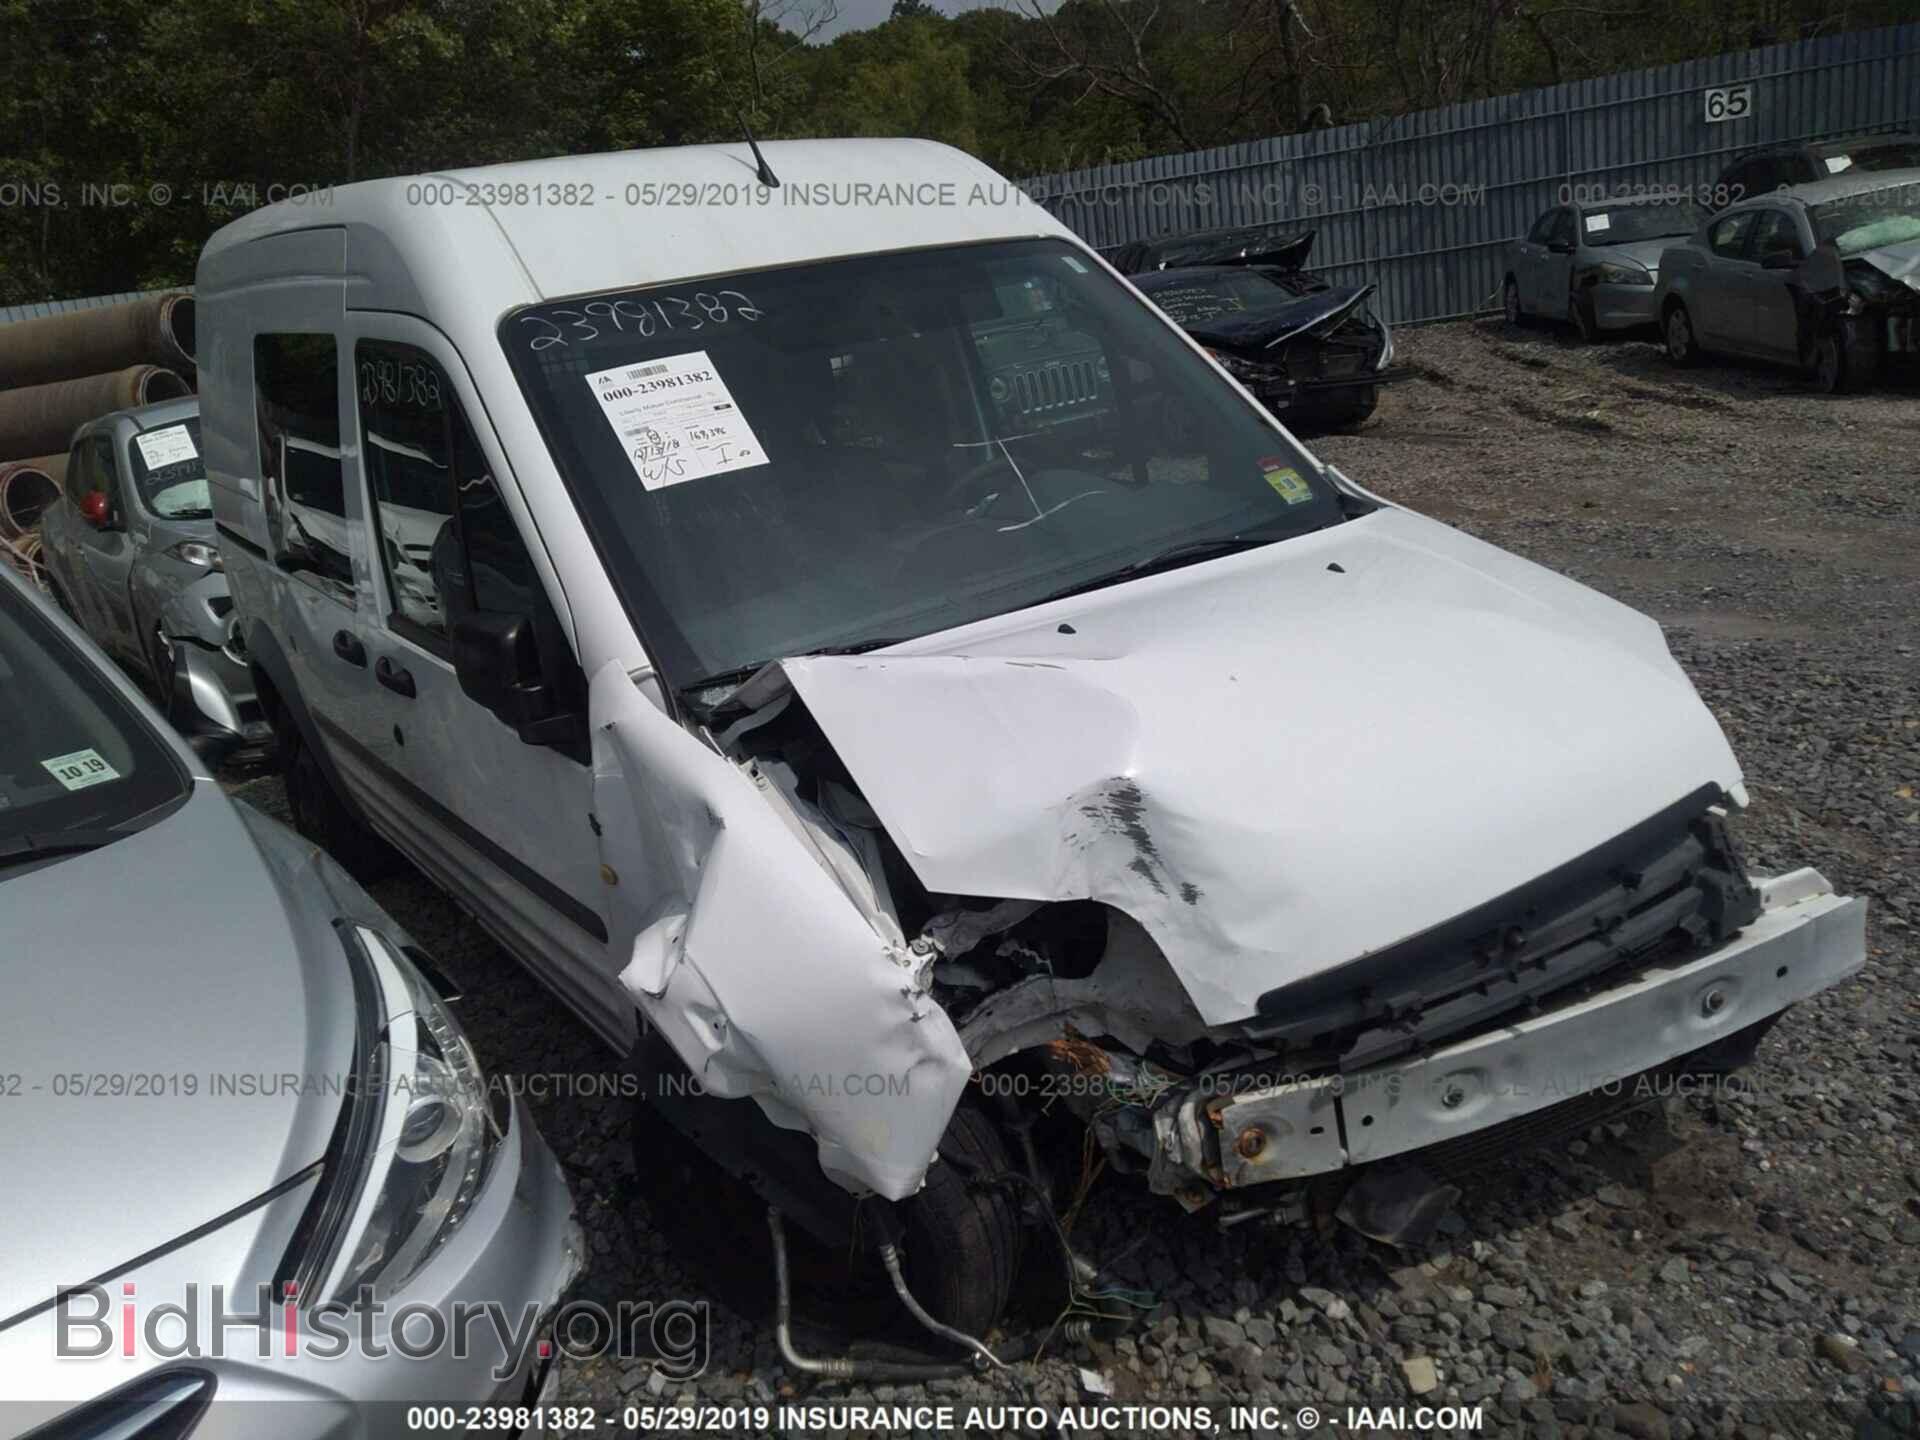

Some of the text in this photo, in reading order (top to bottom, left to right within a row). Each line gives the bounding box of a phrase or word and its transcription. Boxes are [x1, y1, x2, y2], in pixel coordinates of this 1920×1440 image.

[1707, 88, 1748, 119] 65
[520, 290, 766, 351] 23981382
[602, 371, 713, 402] 000-23981382
[59, 758, 105, 780] 10 19
